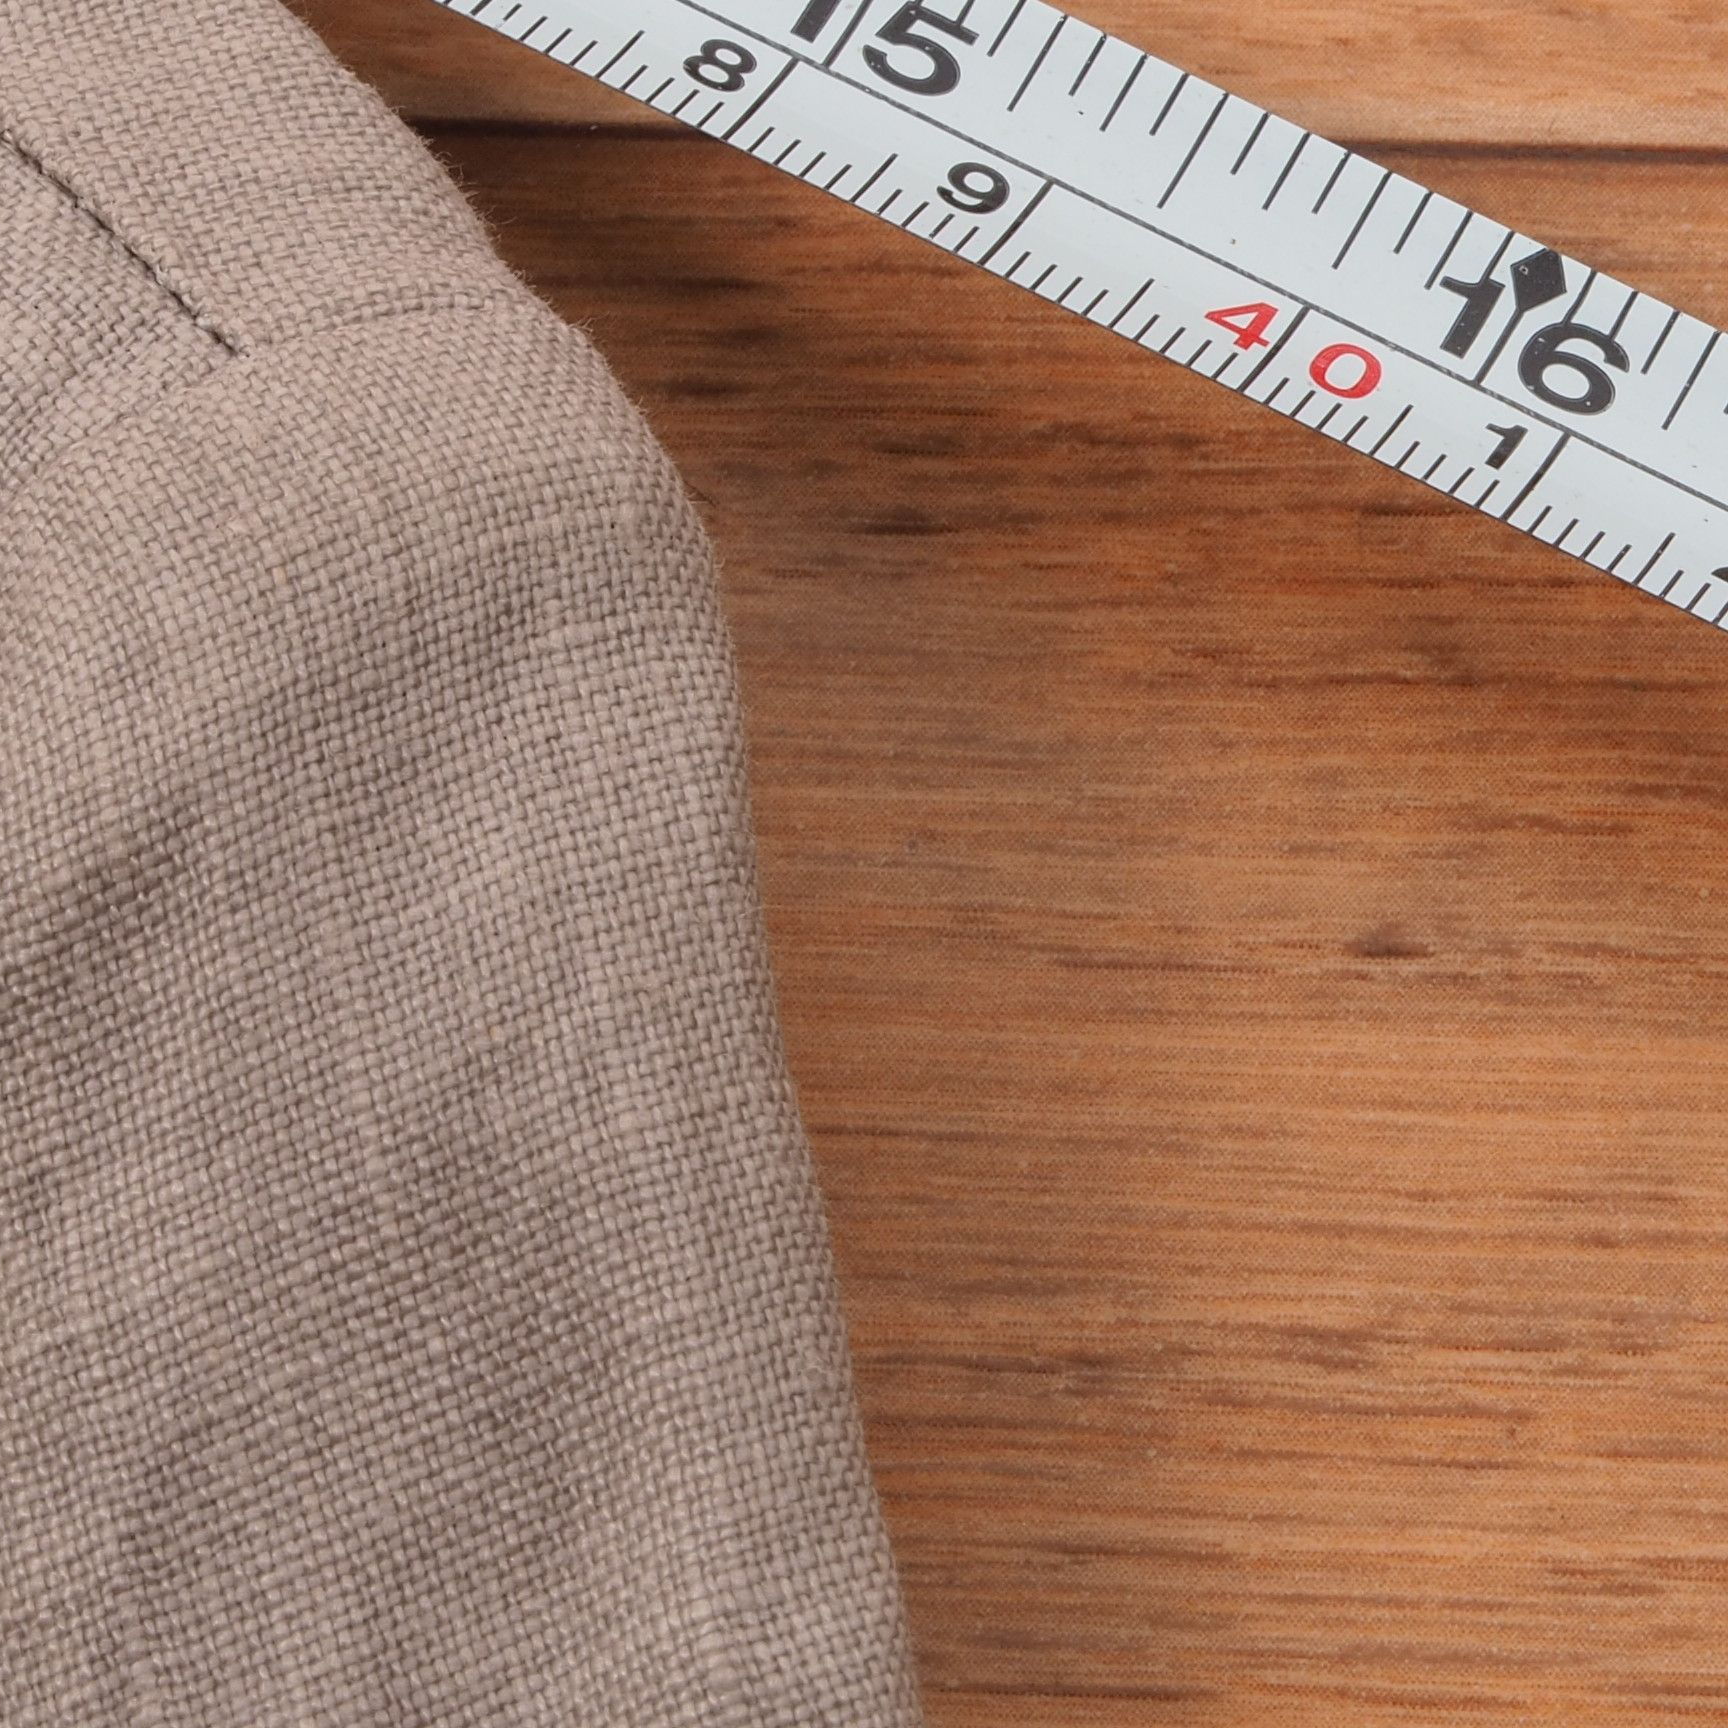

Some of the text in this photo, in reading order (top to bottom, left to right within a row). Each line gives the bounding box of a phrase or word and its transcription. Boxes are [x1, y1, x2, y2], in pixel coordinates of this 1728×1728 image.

[682, 39, 757, 92] 8
[936, 162, 1010, 215] 9
[1205, 302, 1382, 399] 40
[1438, 277, 1632, 416] 16
[1484, 424, 1528, 469] 1
